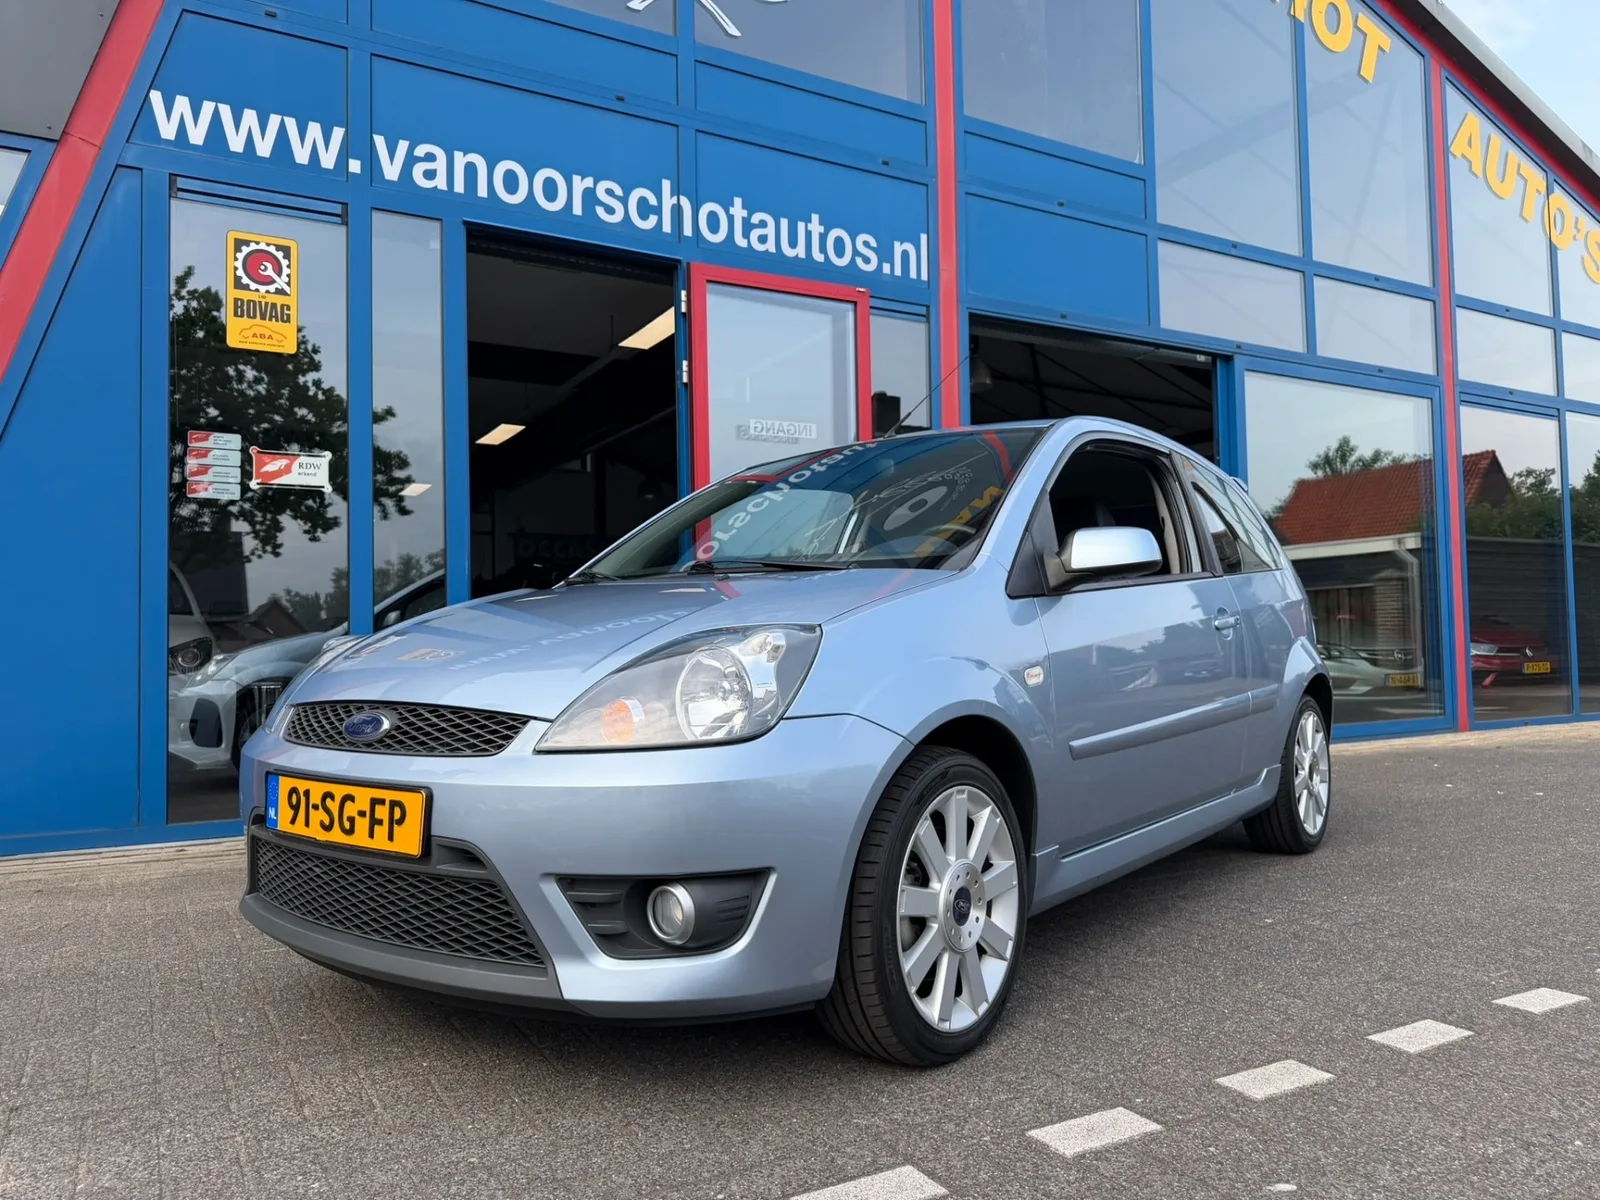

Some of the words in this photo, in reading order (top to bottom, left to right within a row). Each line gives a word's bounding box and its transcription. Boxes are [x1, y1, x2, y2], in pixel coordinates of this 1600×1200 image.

[149, 89, 928, 281] www.vanoorschotautos.nl
[1449, 111, 1600, 284] AUTO'S
[233, 297, 291, 324] BOVAG
[251, 332, 274, 341] ABA
[298, 461, 321, 470] RDW
[349, 716, 378, 736] Ford
[268, 807, 277, 820] NL
[287, 786, 407, 842] 91-SG-FP
